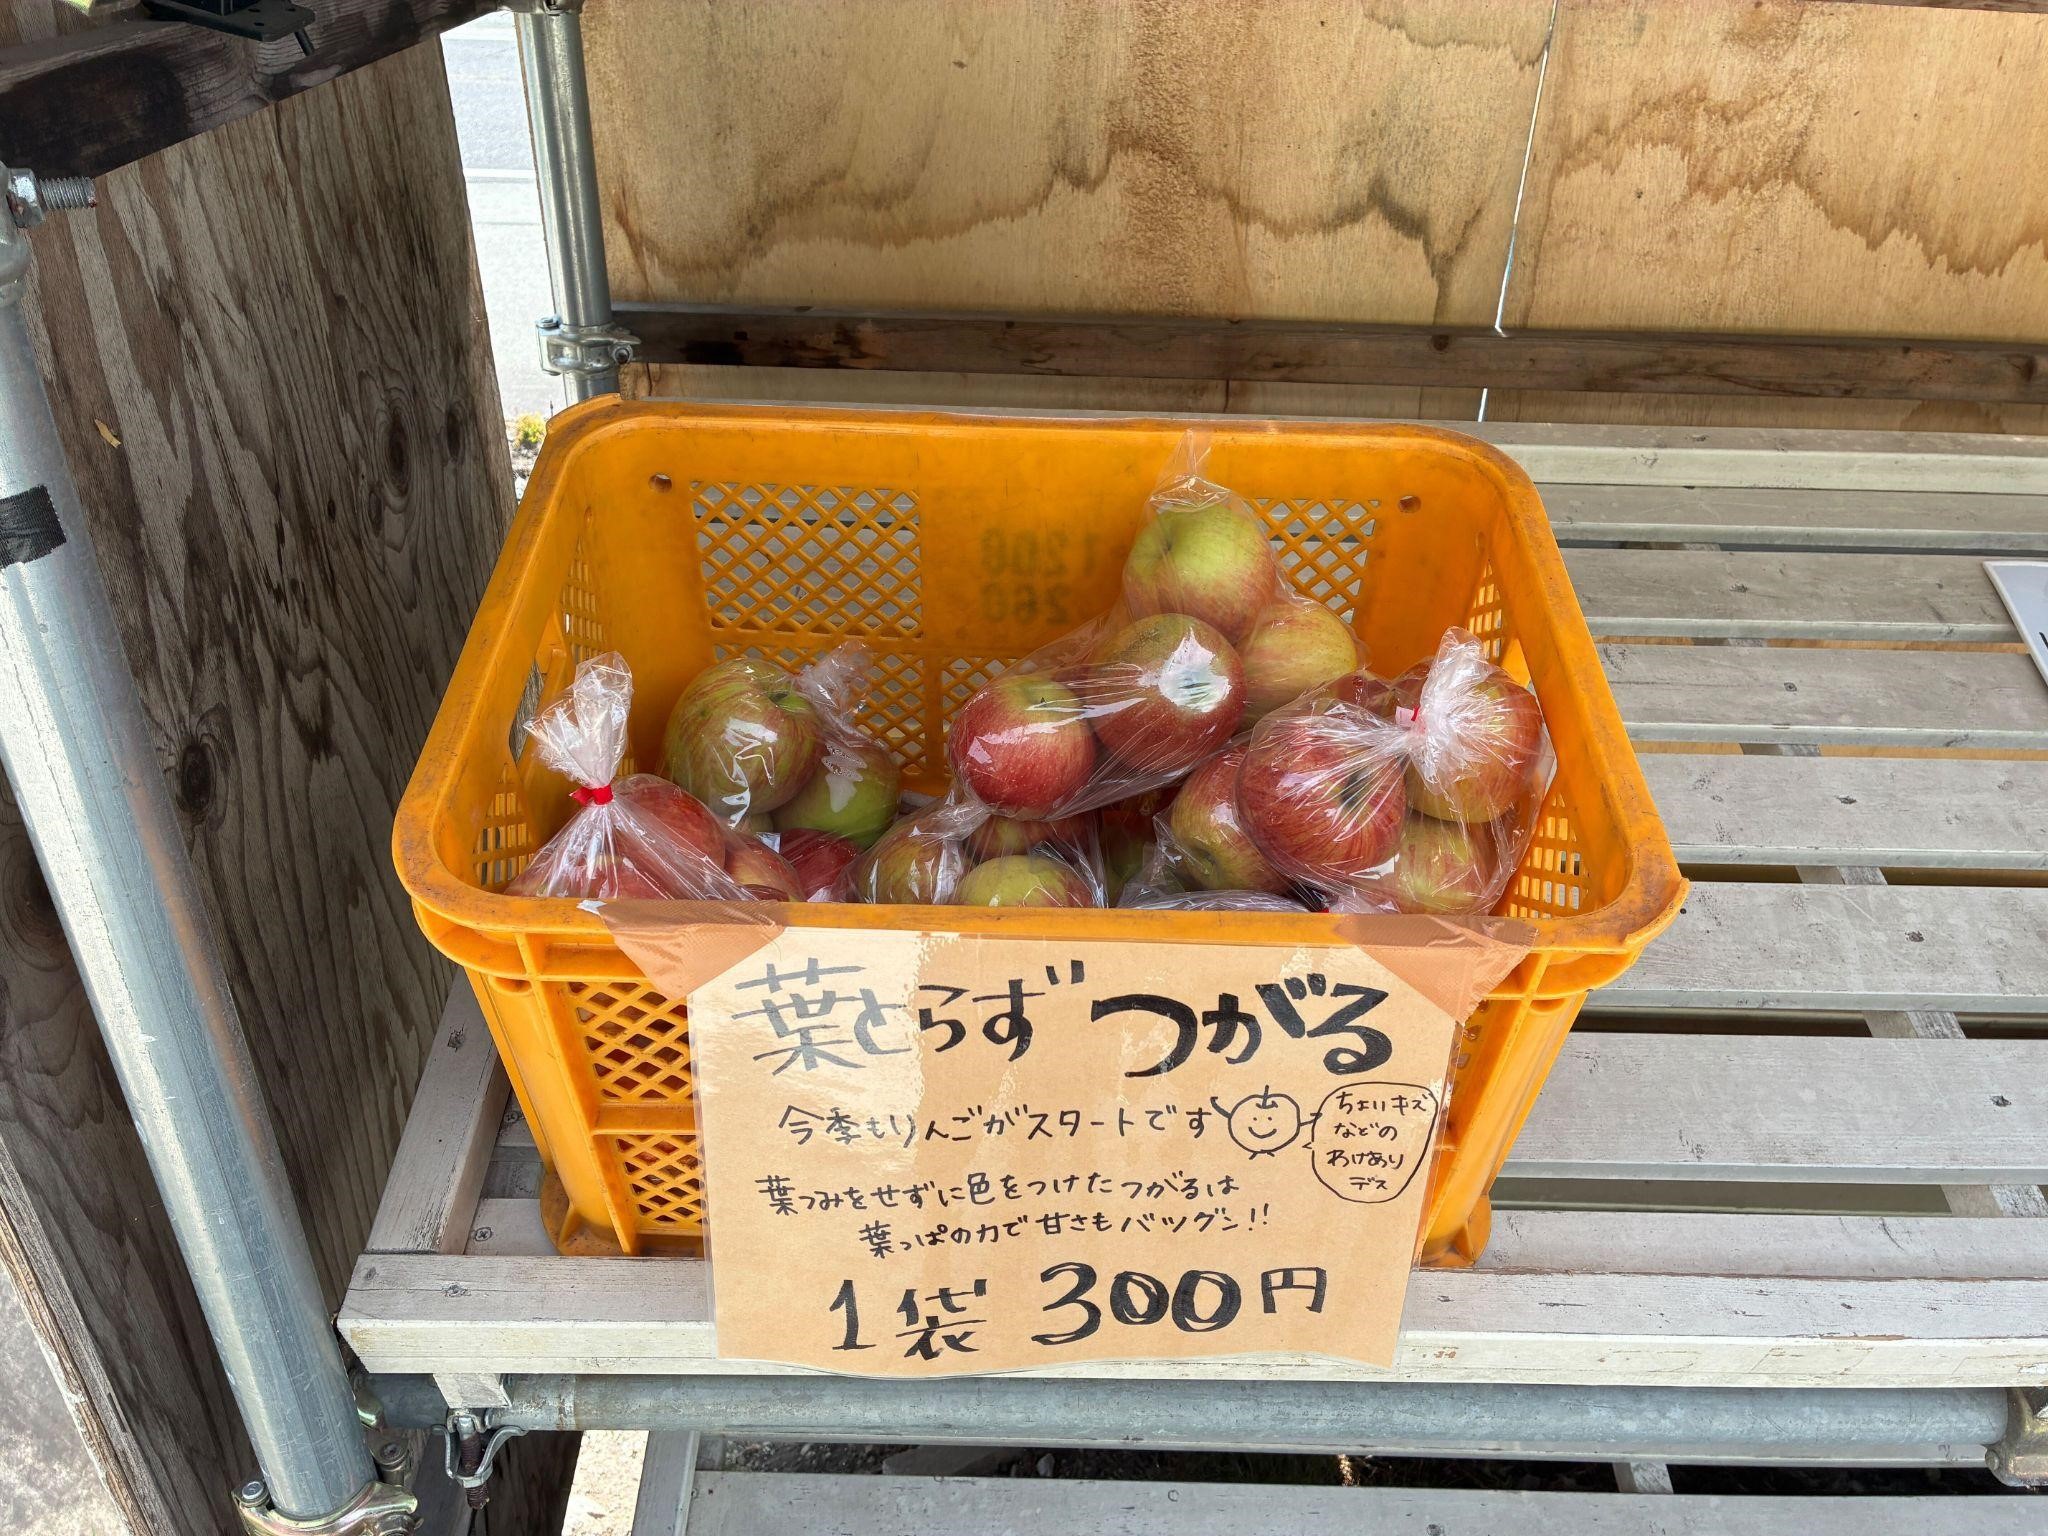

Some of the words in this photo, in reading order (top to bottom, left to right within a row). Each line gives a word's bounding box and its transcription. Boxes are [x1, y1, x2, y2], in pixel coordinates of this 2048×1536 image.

[731, 957, 1084, 1075] 葉とらず
[1091, 973, 1393, 1076] つがる
[1335, 1091, 1432, 1116] ちょいキズ
[778, 1104, 1213, 1148] 今季もりんごがスタートです
[1333, 1121, 1398, 1141] などの
[1326, 1149, 1404, 1170] わけあり
[754, 1171, 1240, 1216] 葉つみをせずに色をつけたつがるは
[1348, 1176, 1388, 1191] デス
[1031, 1262, 1327, 1346] 300円
